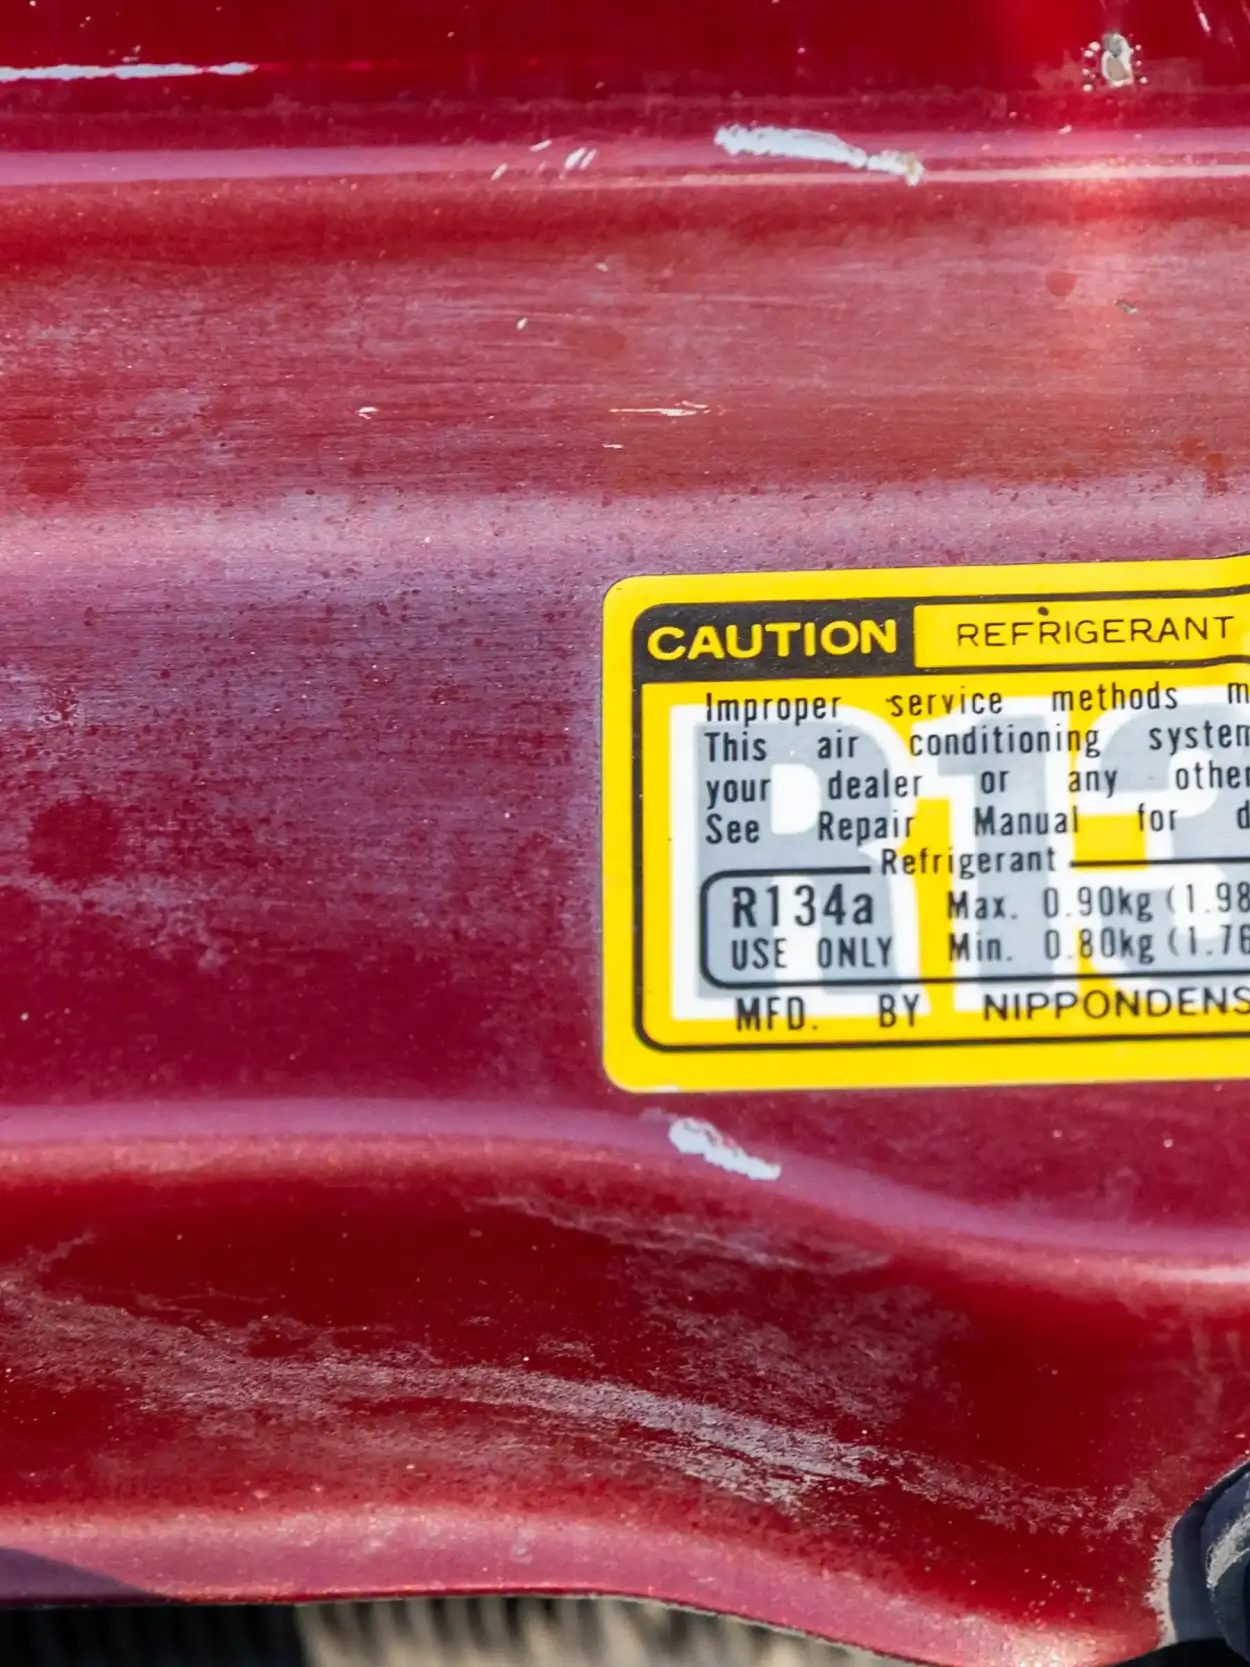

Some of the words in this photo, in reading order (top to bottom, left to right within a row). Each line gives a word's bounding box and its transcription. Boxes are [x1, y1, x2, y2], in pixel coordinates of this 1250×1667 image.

[647, 620, 898, 660] CAUTION
[957, 615, 1235, 647] REFRIGERANT
[705, 692, 842, 727] Improper
[890, 688, 1003, 719] service
[1052, 682, 1178, 713] methods
[704, 730, 768, 763] This
[817, 729, 858, 759] air
[910, 723, 1101, 758] conditioning
[705, 777, 771, 810] your
[828, 768, 922, 800] dealer
[980, 770, 1009, 795] or
[1068, 768, 1118, 799] any
[705, 815, 760, 846] See
[817, 811, 914, 845] Repair
[974, 806, 1079, 838] Manual
[1137, 803, 1177, 833] for
[881, 848, 1057, 879] Refrigerant
[732, 884, 875, 929] R134a
[948, 891, 1018, 921] Max.
[1043, 885, 1154, 922] 0.90kg
[732, 938, 787, 971] USE
[817, 936, 895, 970] ONLY
[948, 933, 1013, 963] Min.
[1044, 928, 1156, 964] 0.80kg
[735, 997, 819, 1032] MFD.
[878, 993, 921, 1028] BY
